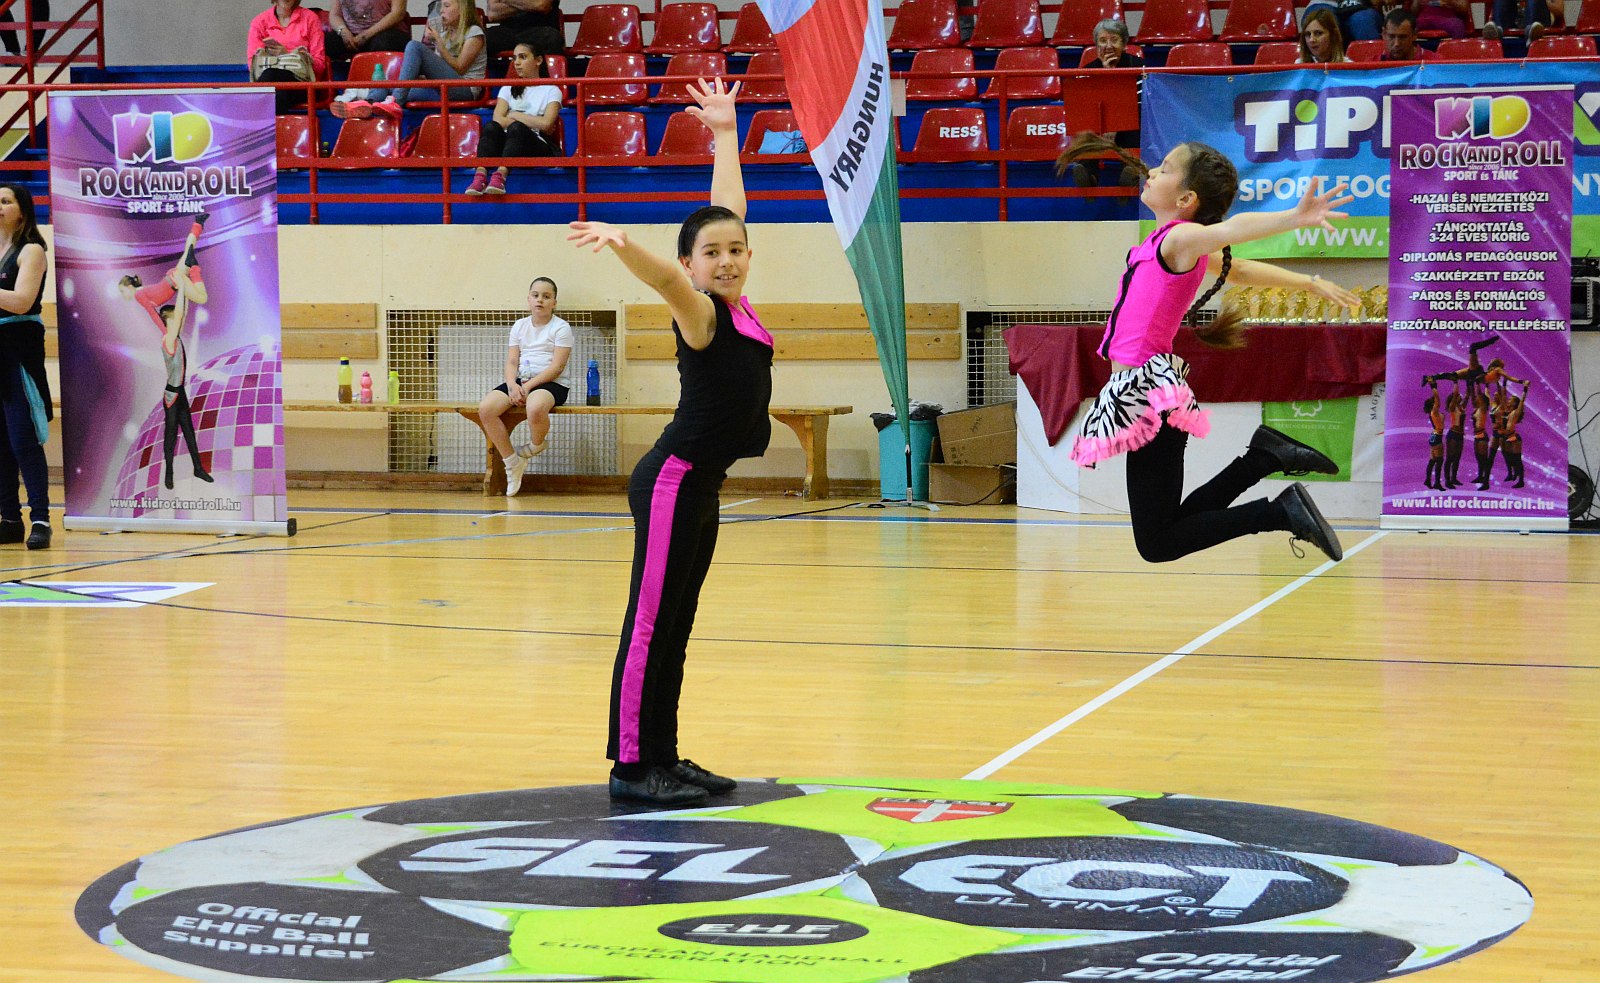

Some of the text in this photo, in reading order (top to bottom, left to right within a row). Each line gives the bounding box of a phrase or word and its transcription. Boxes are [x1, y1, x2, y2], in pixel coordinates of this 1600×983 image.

[1434, 95, 1532, 140] KID
[939, 125, 980, 138] RESS
[1026, 122, 1066, 136] RESS
[112, 110, 213, 164] KID
[1443, 170, 1478, 181] SPORT
[1491, 167, 1519, 181] TÁNC
[1238, 175, 1329, 201] SPORT
[1451, 192, 1468, 203] ÉS
[1470, 192, 1549, 203] NEMZETKÖZI
[128, 201, 162, 214] SPORT
[177, 198, 205, 213] TÁNC
[1426, 202, 1535, 214] VERSENYEZTETÉS
[1429, 231, 1530, 242] 3-24 ÉVES KORIG
[1465, 250, 1558, 261] PEDAGÓGUSOK
[1455, 289, 1471, 301] ÉS
[1474, 289, 1546, 301] FORMÁCIÓS
[1429, 301, 1527, 311] ROCK AND ROLL
[1488, 319, 1566, 331] FELLÉPÉSEK
[110, 498, 242, 512] www.kidrockandroll.hu
[1392, 496, 1555, 511] www.kidrockandroll.hu
[197, 902, 362, 929] Official
[172, 916, 370, 945] EHF Ball
[691, 923, 840, 934] EHF
[164, 930, 376, 960] Supplier
[539, 941, 909, 963] EUROPEAN HANDBALL
[606, 951, 818, 966] FEDERATION
[1136, 952, 1342, 967] Official
[1061, 966, 1316, 981] EHF Ball
